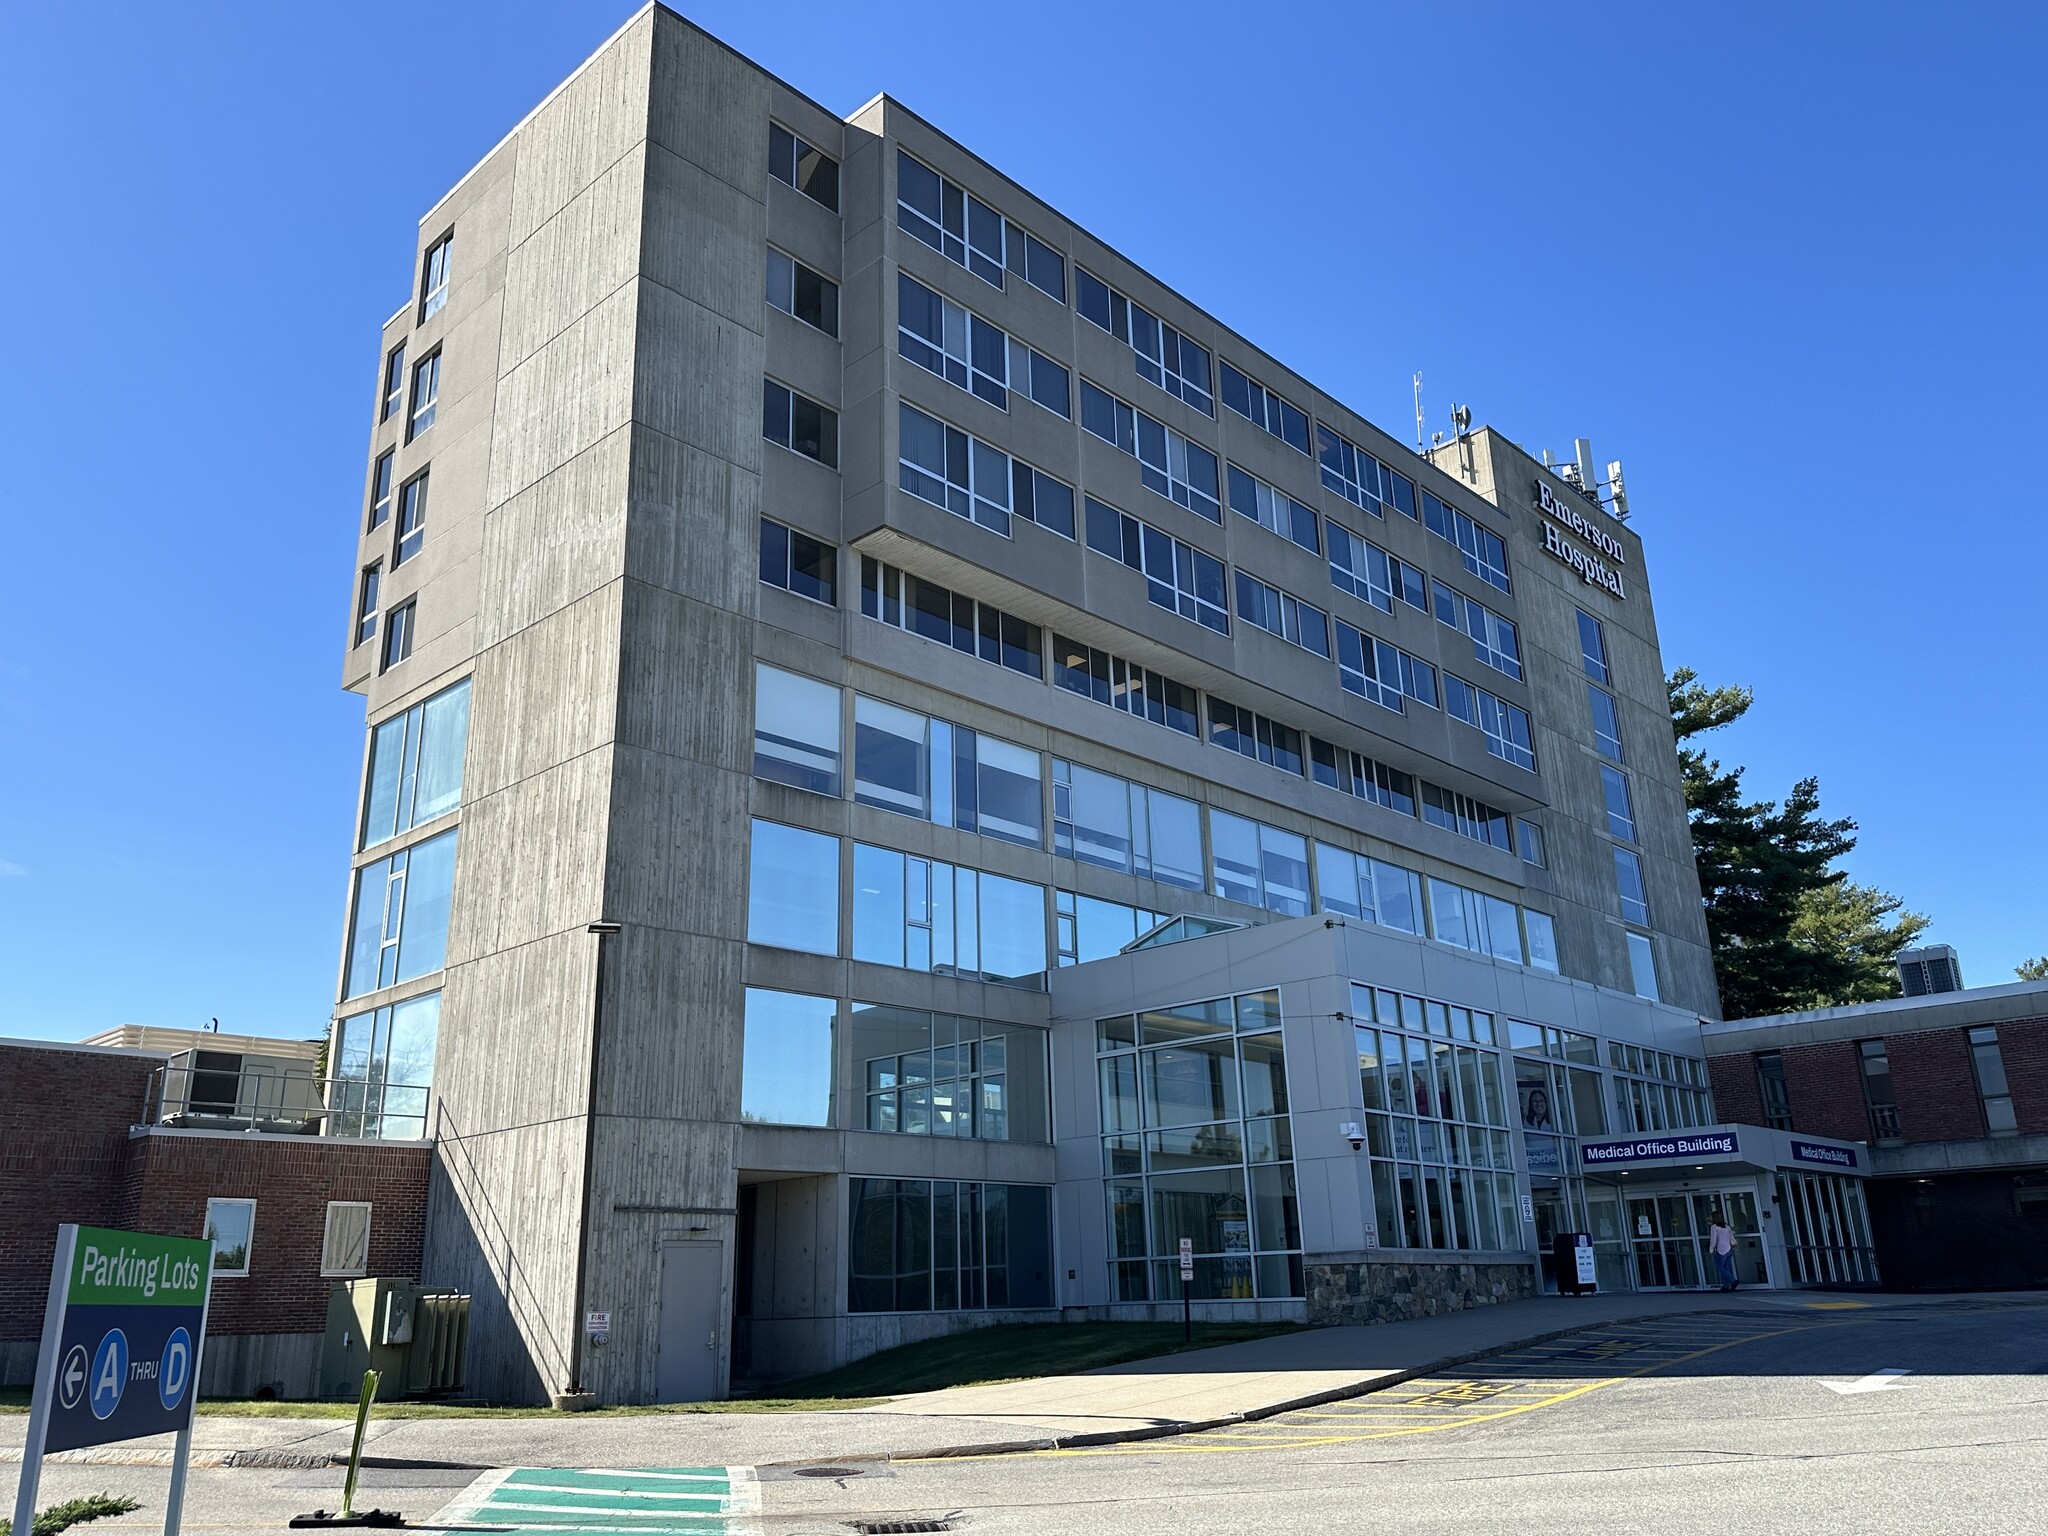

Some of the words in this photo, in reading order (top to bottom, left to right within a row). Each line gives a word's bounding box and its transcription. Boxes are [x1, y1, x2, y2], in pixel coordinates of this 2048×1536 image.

[1537, 479, 1625, 564] Emerson
[1543, 520, 1626, 600] Hospital
[1587, 1144, 1634, 1159] Medical
[1637, 1143, 1675, 1155] Office
[1678, 1138, 1733, 1152] Building
[1801, 1146, 1818, 1159] Medical
[1818, 1149, 1831, 1160] Office
[1831, 1151, 1849, 1165] Building
[80, 1246, 159, 1297] Parking
[161, 1253, 199, 1290] Lots
[95, 1342, 118, 1401] A
[130, 1360, 159, 1381] THRU
[165, 1342, 187, 1396] D
